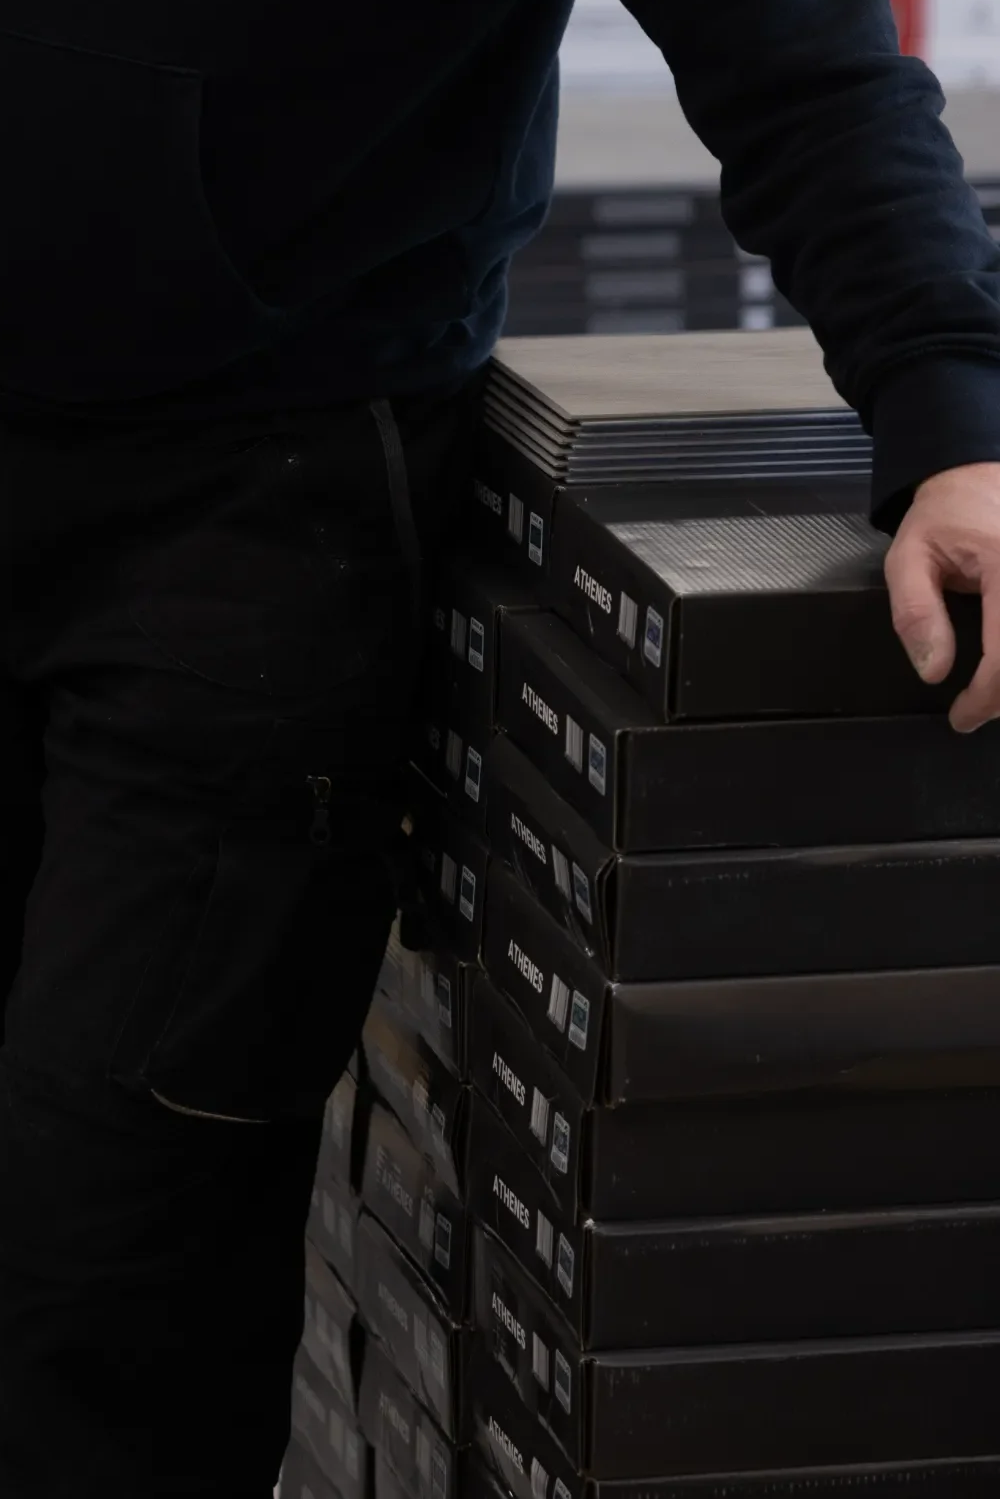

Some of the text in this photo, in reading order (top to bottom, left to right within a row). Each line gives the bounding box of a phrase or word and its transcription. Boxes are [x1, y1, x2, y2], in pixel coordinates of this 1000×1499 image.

[573, 564, 613, 615] ATHENES
[521, 682, 559, 735] ATHENES
[510, 812, 548, 865] ATHENES
[507, 938, 545, 994] ATHENES
[491, 1051, 527, 1107] ATHENES
[492, 1174, 531, 1230] ATHENES
[491, 1291, 527, 1351] ATHENES
[487, 1415, 525, 1474] ATHENES
